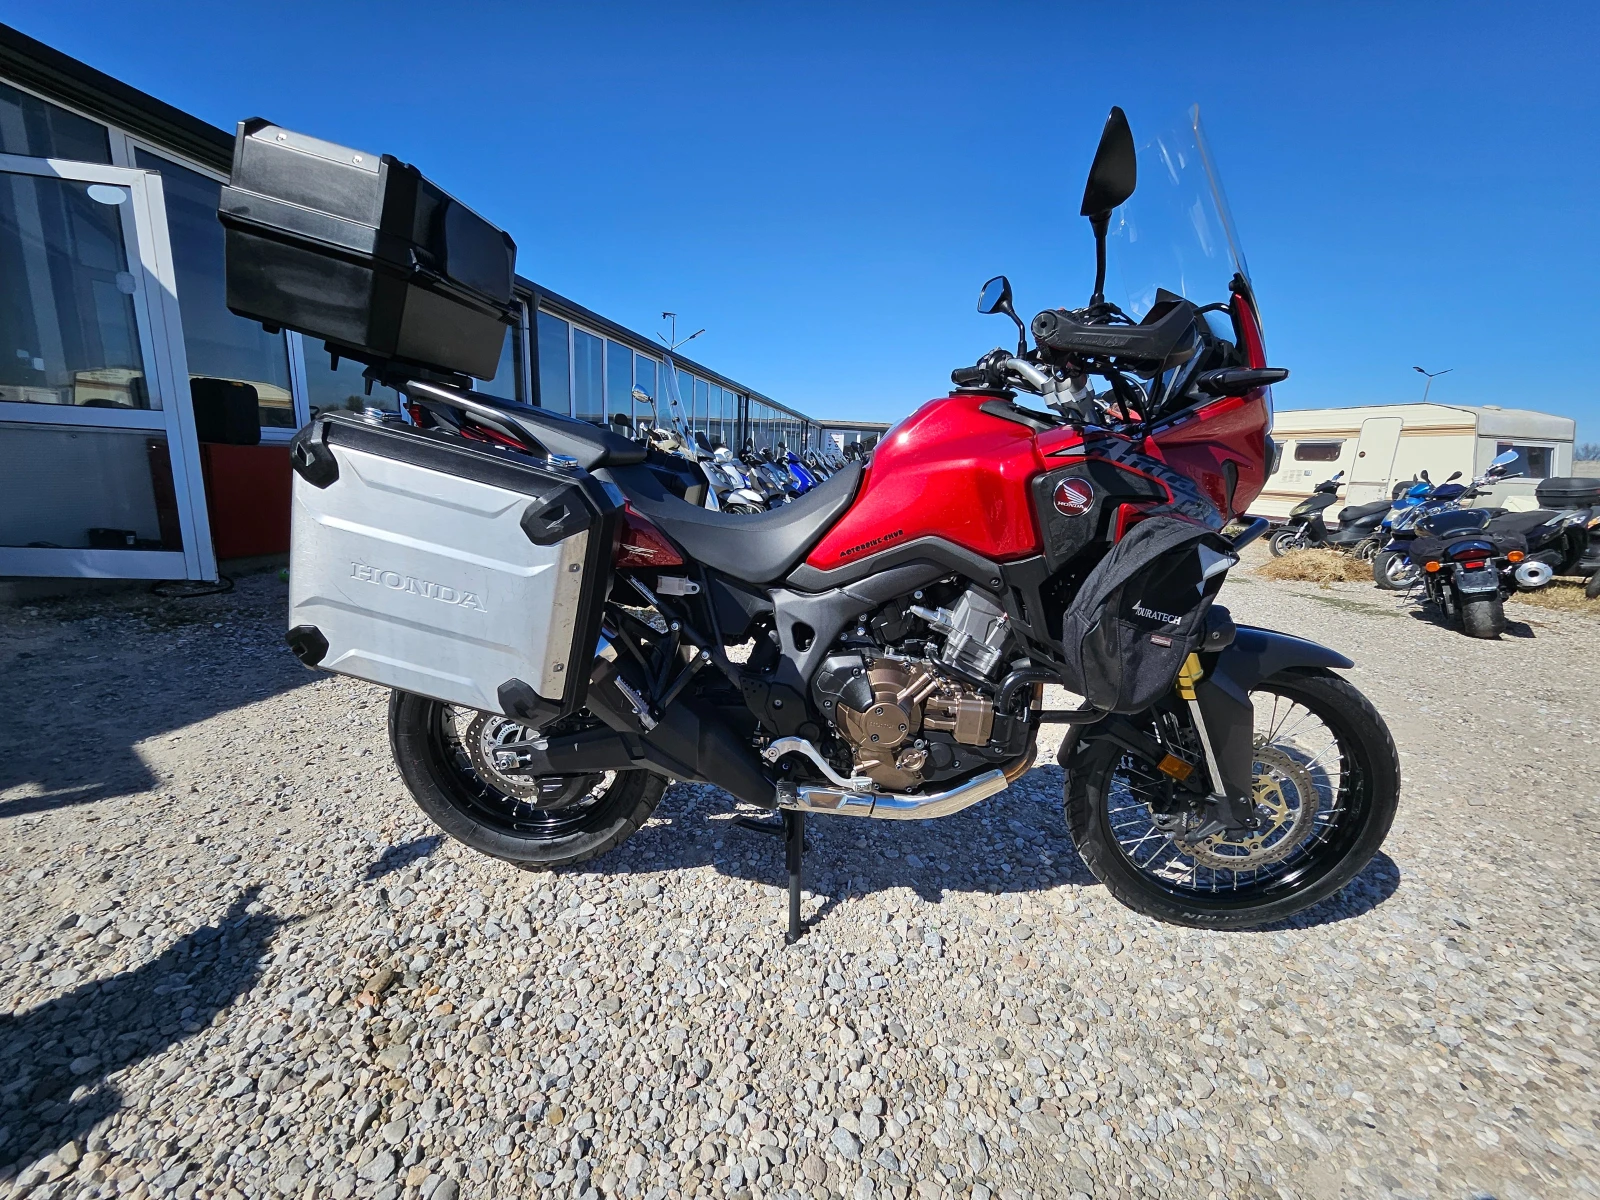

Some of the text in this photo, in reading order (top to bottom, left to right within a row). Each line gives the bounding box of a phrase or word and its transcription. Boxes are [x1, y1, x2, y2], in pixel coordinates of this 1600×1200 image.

[1057, 501, 1085, 509] HONDA
[350, 561, 488, 613] HONDA
[1133, 601, 1182, 625] TOURATECH
